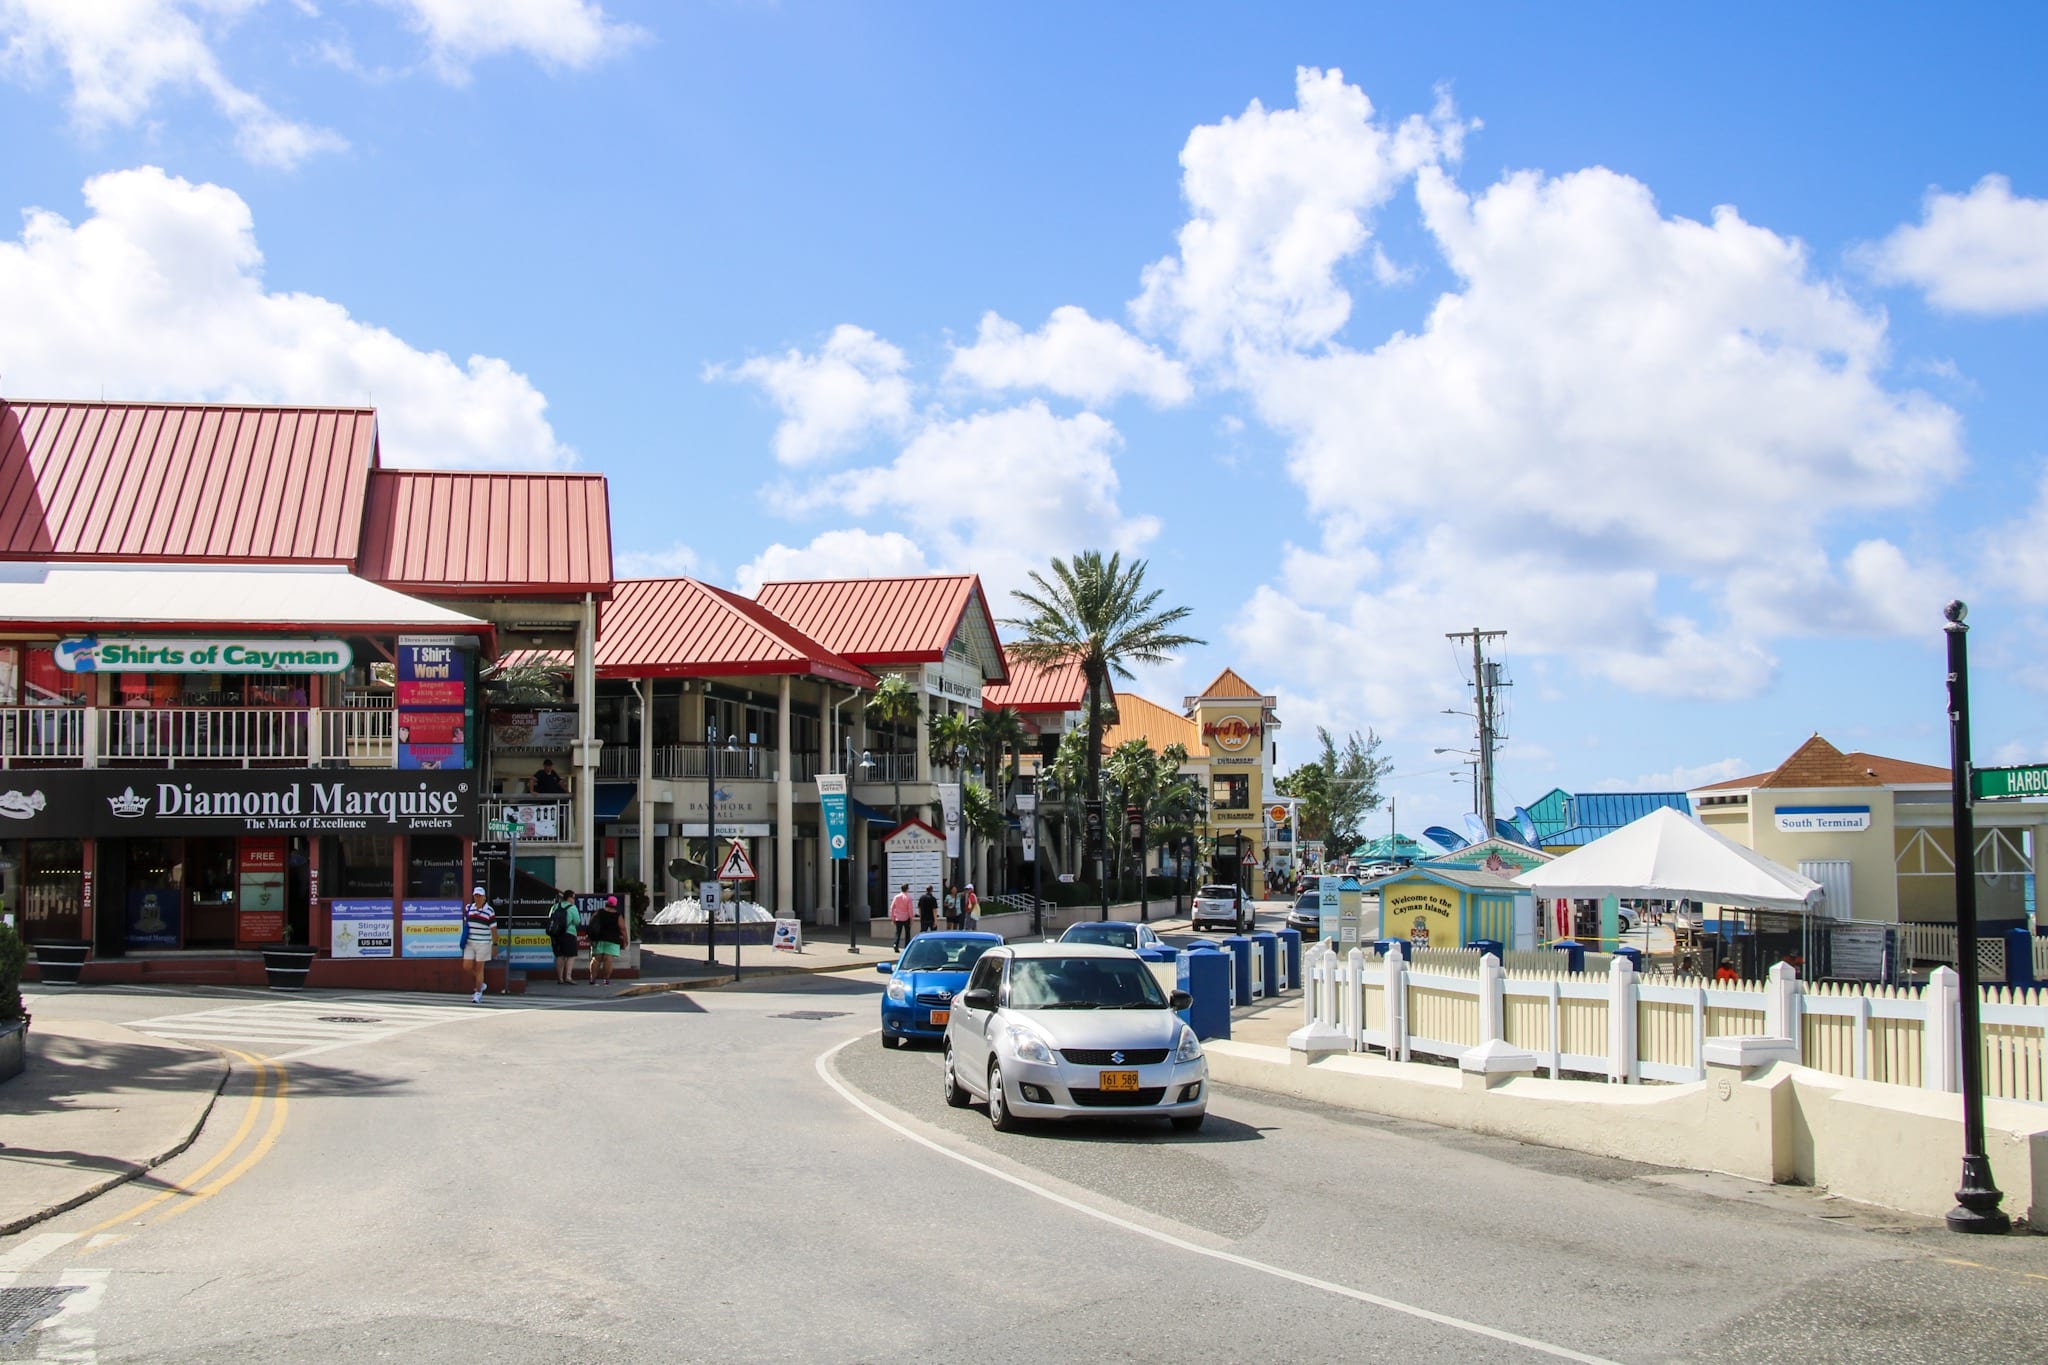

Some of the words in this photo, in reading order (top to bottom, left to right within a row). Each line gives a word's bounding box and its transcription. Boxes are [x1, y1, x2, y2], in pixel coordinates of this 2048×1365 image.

[101, 645, 184, 664] Shirts
[190, 646, 219, 664] of
[223, 645, 339, 668] Cayman
[412, 647, 419, 662] T
[421, 647, 451, 662] Shirt
[414, 663, 449, 679] World
[1203, 721, 1232, 736] Hard
[1233, 721, 1260, 737] Rock
[1225, 737, 1242, 745] CAFE
[156, 783, 301, 815] Diamond
[245, 818, 265, 829] The
[268, 818, 297, 829] Mark
[300, 818, 311, 829] of
[313, 818, 366, 829] Excellence
[408, 818, 452, 829] Jewelers
[489, 822, 509, 831] GORING
[1782, 818, 1812, 828] South
[1816, 818, 1863, 827] Terminal
[250, 852, 275, 861] FREE
[424, 859, 454, 867] Diamond
[520, 897, 556, 905] International
[578, 898, 584, 911] T
[587, 898, 608, 912] Shir
[1391, 895, 1428, 906] Welcome
[1439, 898, 1452, 908] the
[1393, 904, 1423, 915] Cayman
[1425, 903, 1450, 917] Islands
[358, 922, 390, 931] Stingray
[514, 936, 551, 945] Gemston
[1103, 1074, 1116, 1085] 161
[1122, 1074, 1137, 1085] 589
